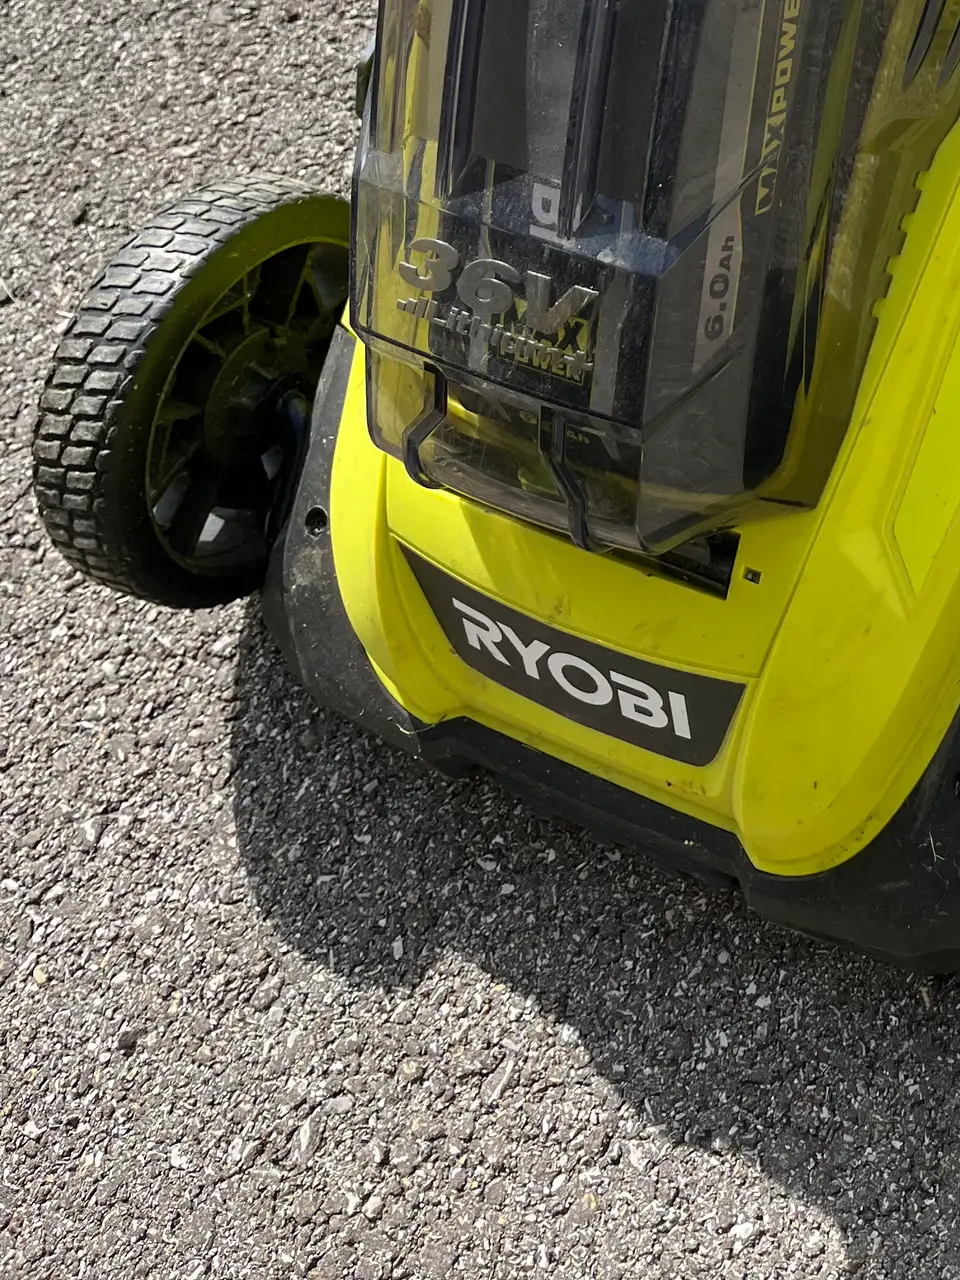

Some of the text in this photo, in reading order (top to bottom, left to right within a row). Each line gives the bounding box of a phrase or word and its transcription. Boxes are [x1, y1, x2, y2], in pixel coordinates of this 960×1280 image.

[399, 237, 600, 335] 36V
[704, 234, 735, 340] 6.0Ah
[452, 597, 692, 740] RYOBI
